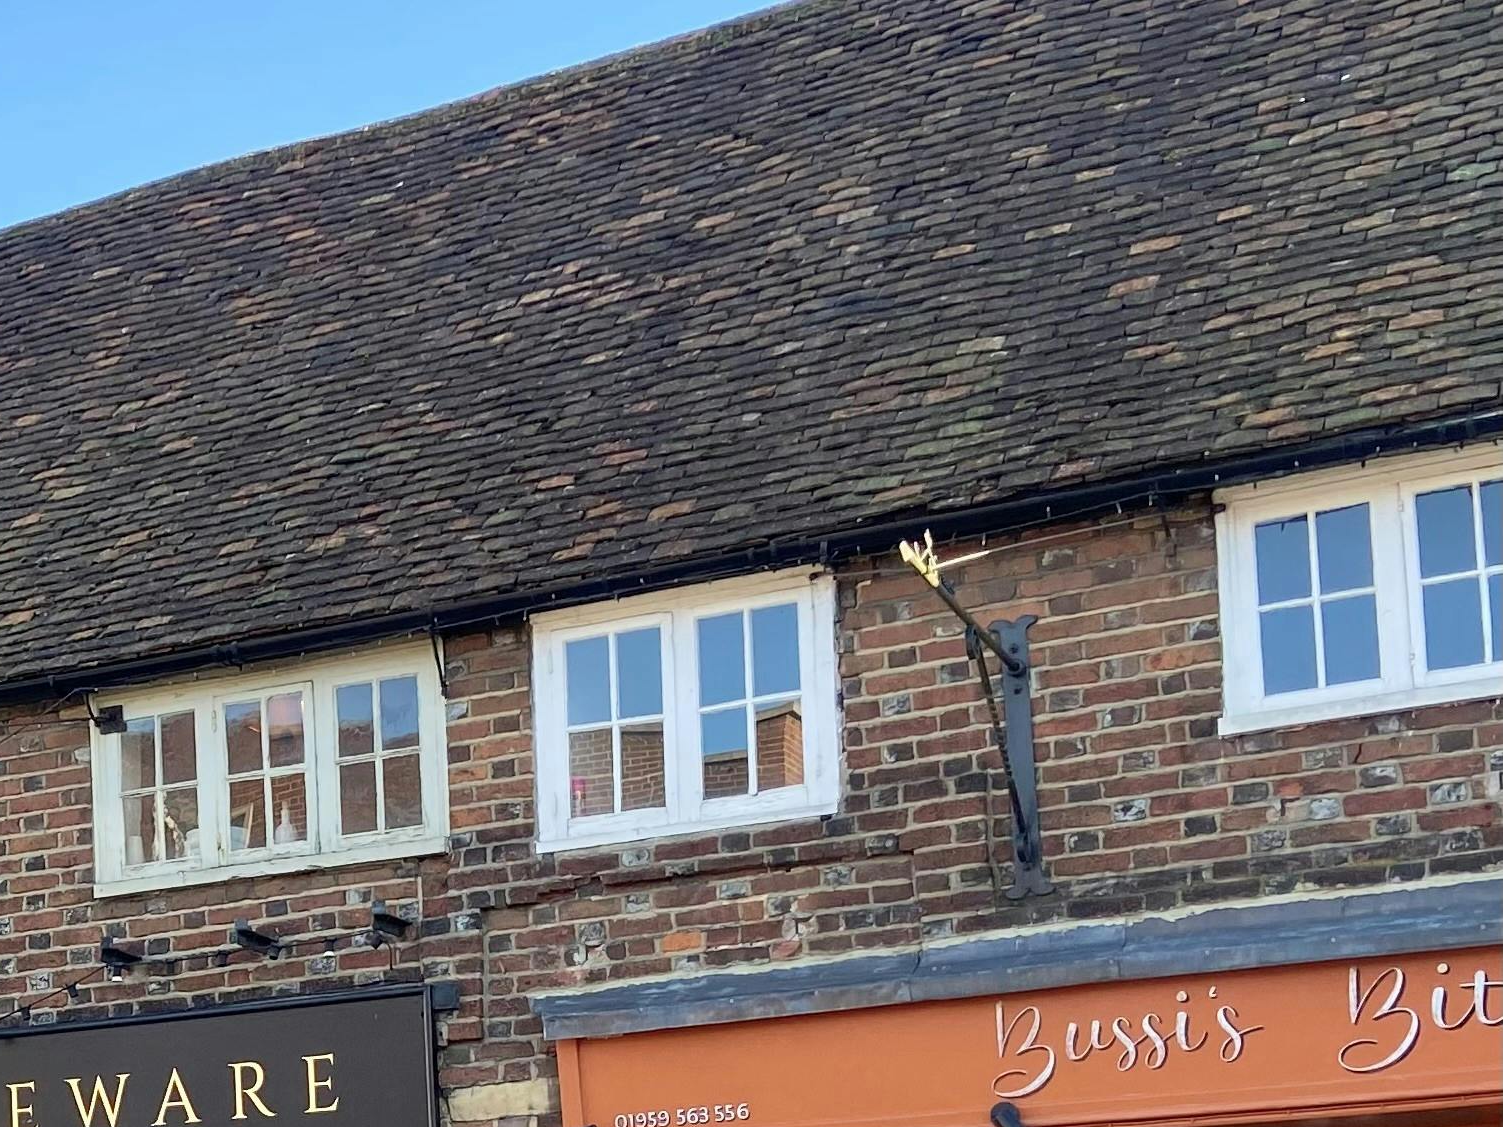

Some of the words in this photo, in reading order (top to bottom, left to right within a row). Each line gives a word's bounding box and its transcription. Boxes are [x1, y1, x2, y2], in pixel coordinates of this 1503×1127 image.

[991, 985, 1265, 1098] Bussi's
[675, 1106, 710, 1126] 563
[714, 1102, 750, 1122] 556
